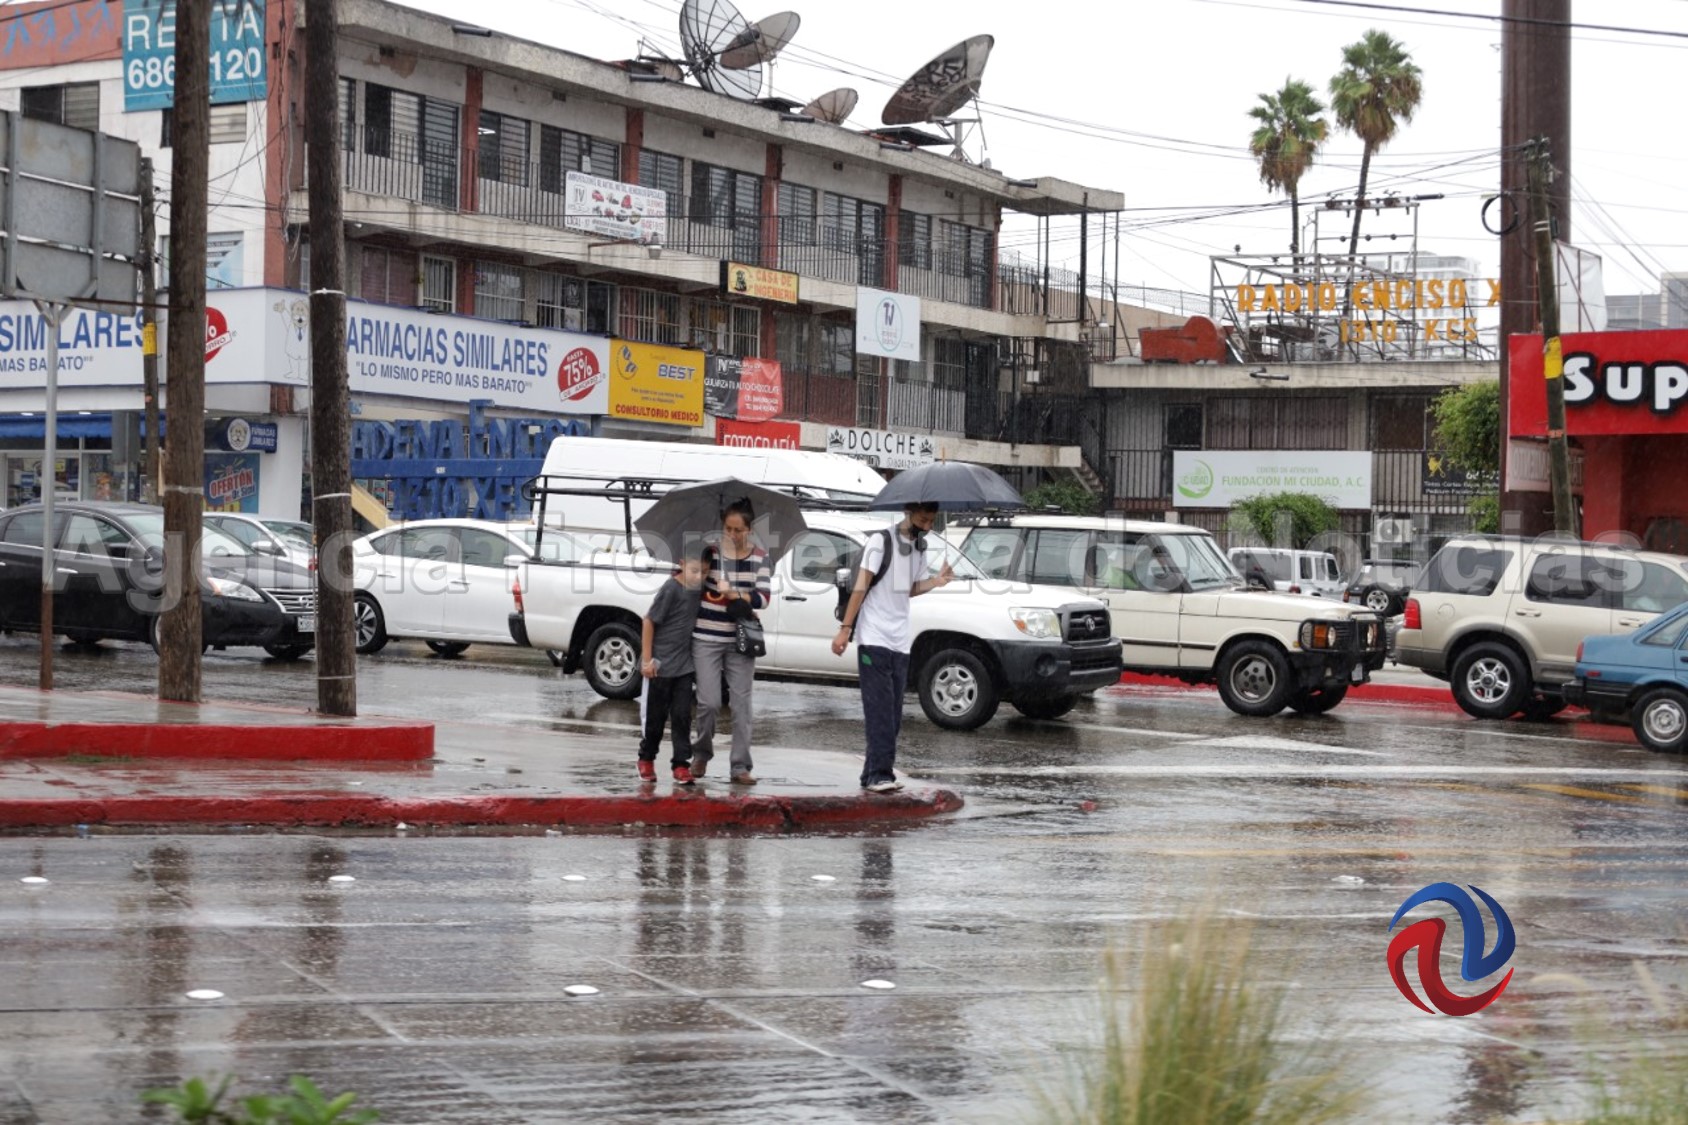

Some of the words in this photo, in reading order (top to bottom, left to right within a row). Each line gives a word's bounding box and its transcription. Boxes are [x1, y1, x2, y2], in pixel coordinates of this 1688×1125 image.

[127, 3, 261, 51] RETA
[781, 272, 793, 288] DE
[1236, 282, 1336, 312] RADIO
[1352, 279, 1466, 311] ENCISO
[0, 309, 145, 352] SIMLARES
[346, 315, 448, 365] ARMACIAS
[453, 330, 548, 377] SIMILARES
[380, 365, 418, 382] MISMO
[421, 369, 452, 386] PERO
[455, 373, 480, 389] MAS
[563, 356, 593, 387] 75%
[657, 363, 696, 381] BEST
[615, 403, 669, 419] CONSULTORIO
[671, 411, 700, 423] MEDICO
[848, 429, 915, 455] DOLCHE
[1284, 477, 1297, 486] MI
